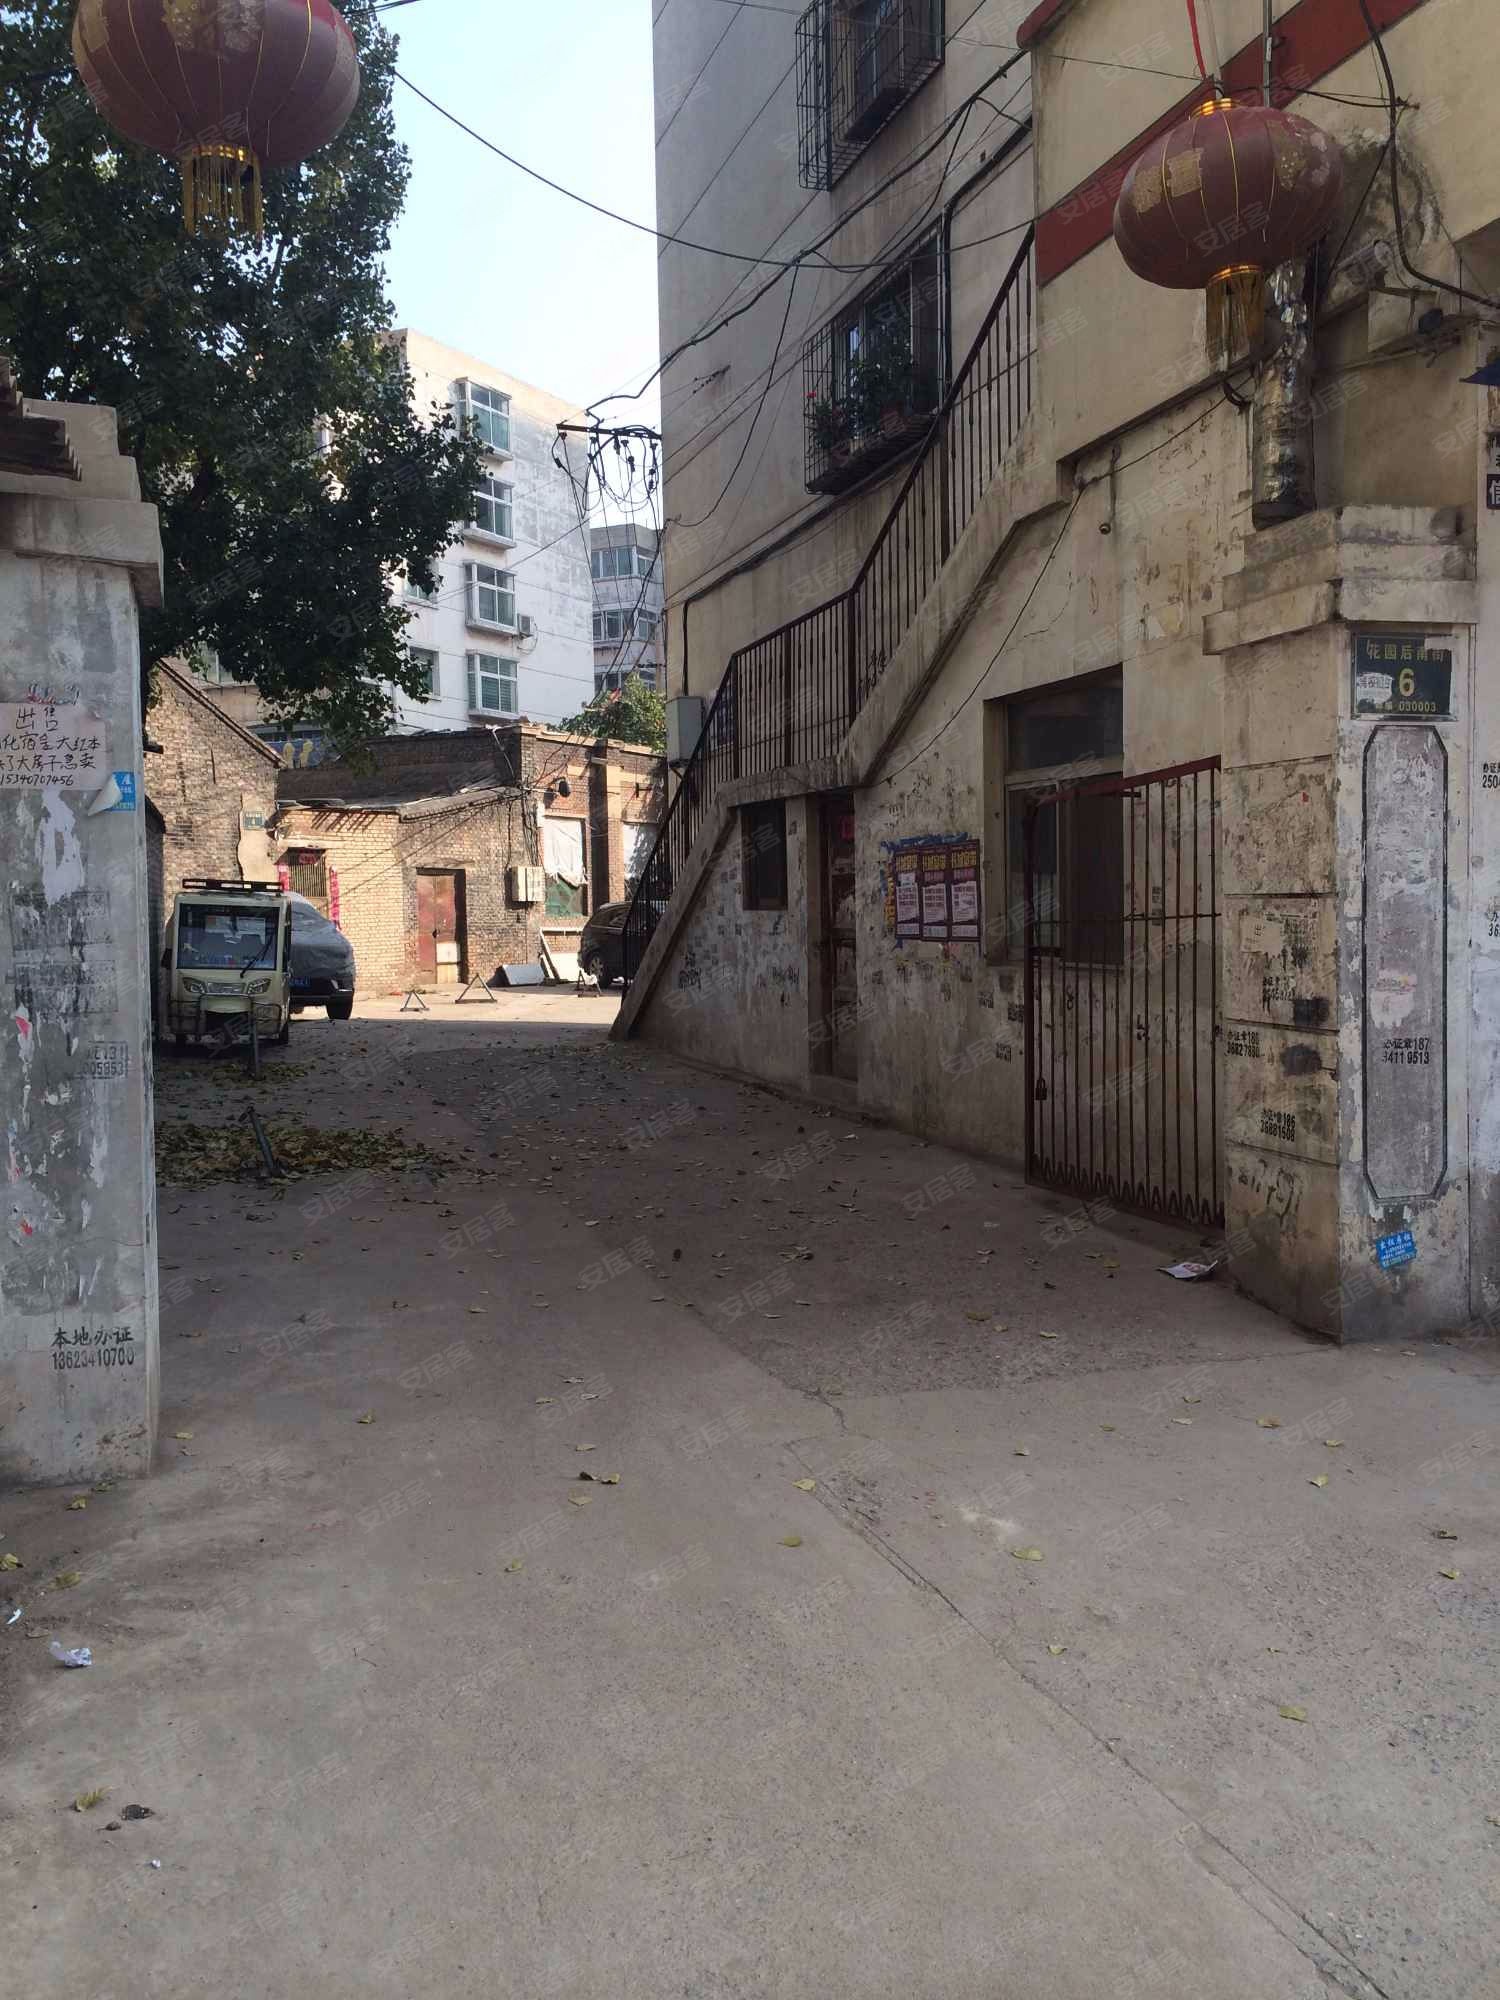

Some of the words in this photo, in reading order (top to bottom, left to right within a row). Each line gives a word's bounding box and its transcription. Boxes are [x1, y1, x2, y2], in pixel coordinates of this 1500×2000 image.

[1399, 667, 1416, 697] 6
[51, 1326, 134, 1348] 本地办证
